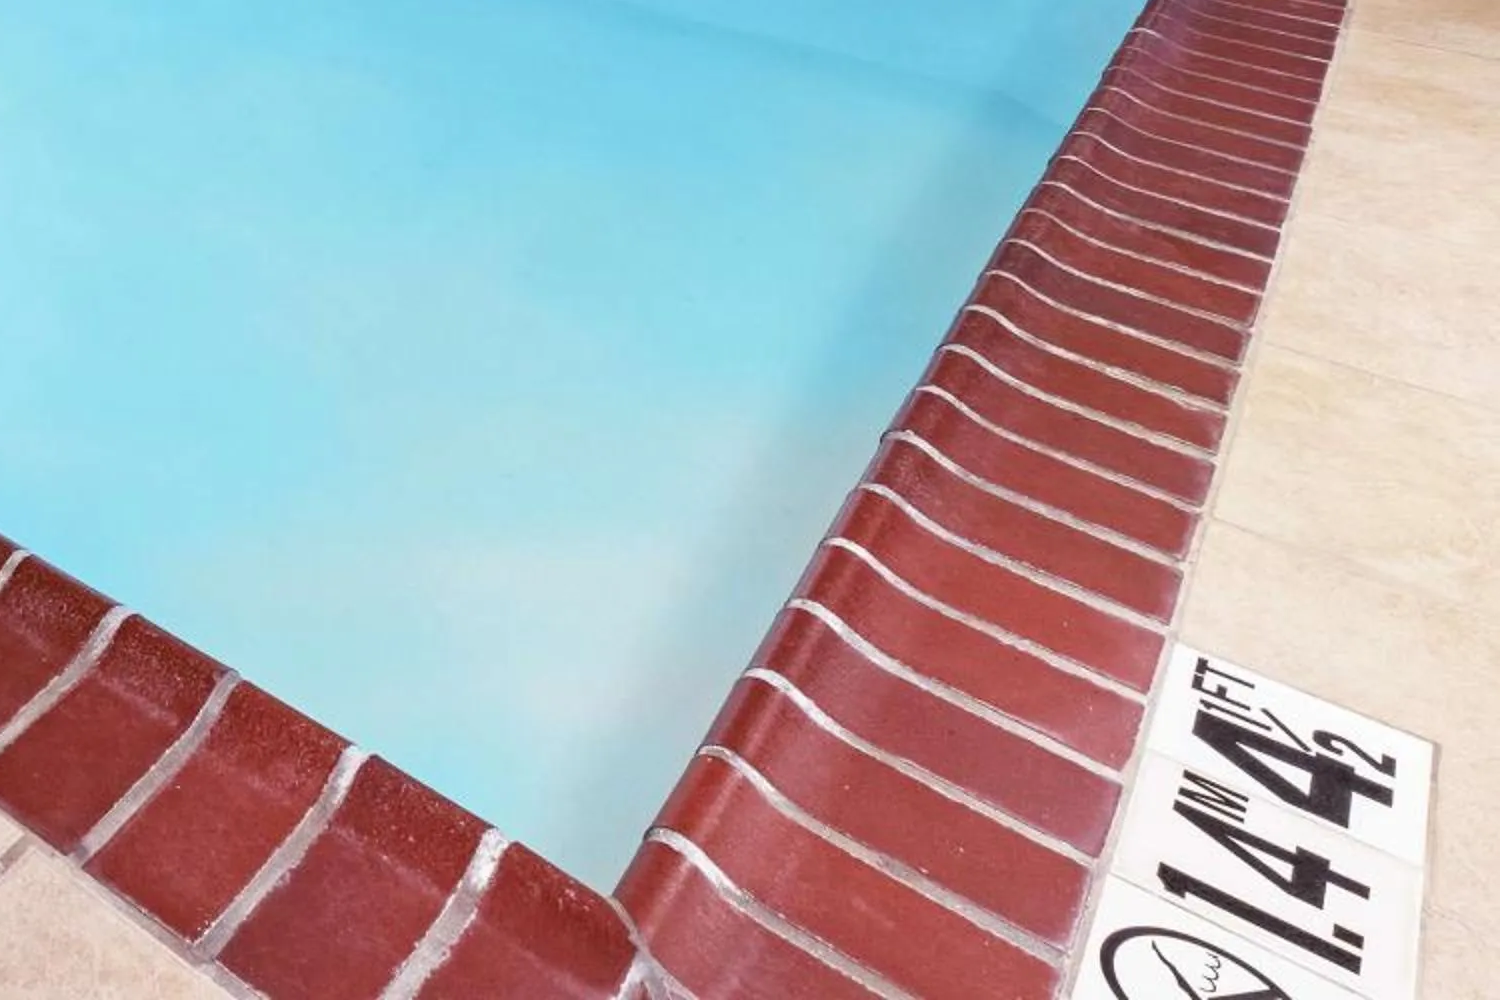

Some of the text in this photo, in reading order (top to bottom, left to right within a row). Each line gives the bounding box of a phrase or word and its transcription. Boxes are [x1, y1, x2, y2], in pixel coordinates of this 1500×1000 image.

[1177, 769, 1249, 823] M
[1191, 709, 1394, 829] 4
[1157, 799, 1371, 975] 1.4
